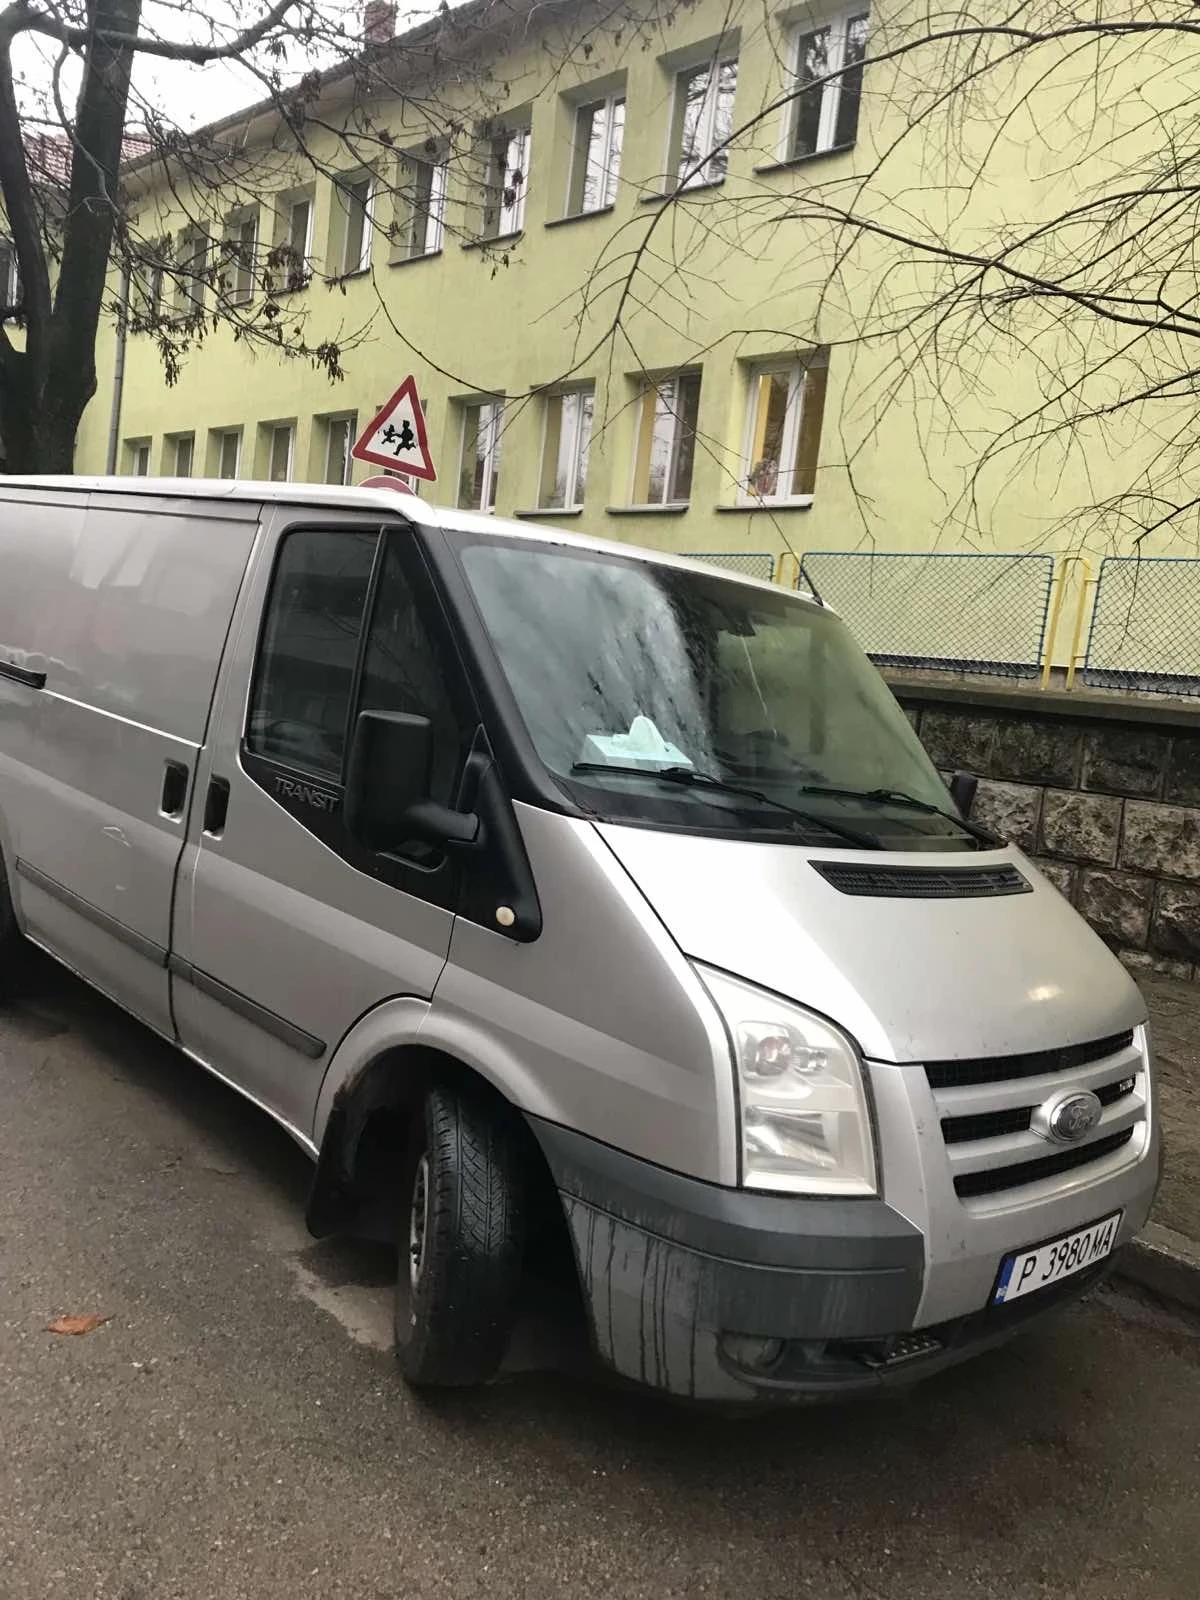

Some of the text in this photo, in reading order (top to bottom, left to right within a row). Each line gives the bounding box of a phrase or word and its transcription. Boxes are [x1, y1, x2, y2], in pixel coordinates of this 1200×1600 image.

[1016, 1221, 1114, 1291] P 3980 MA
